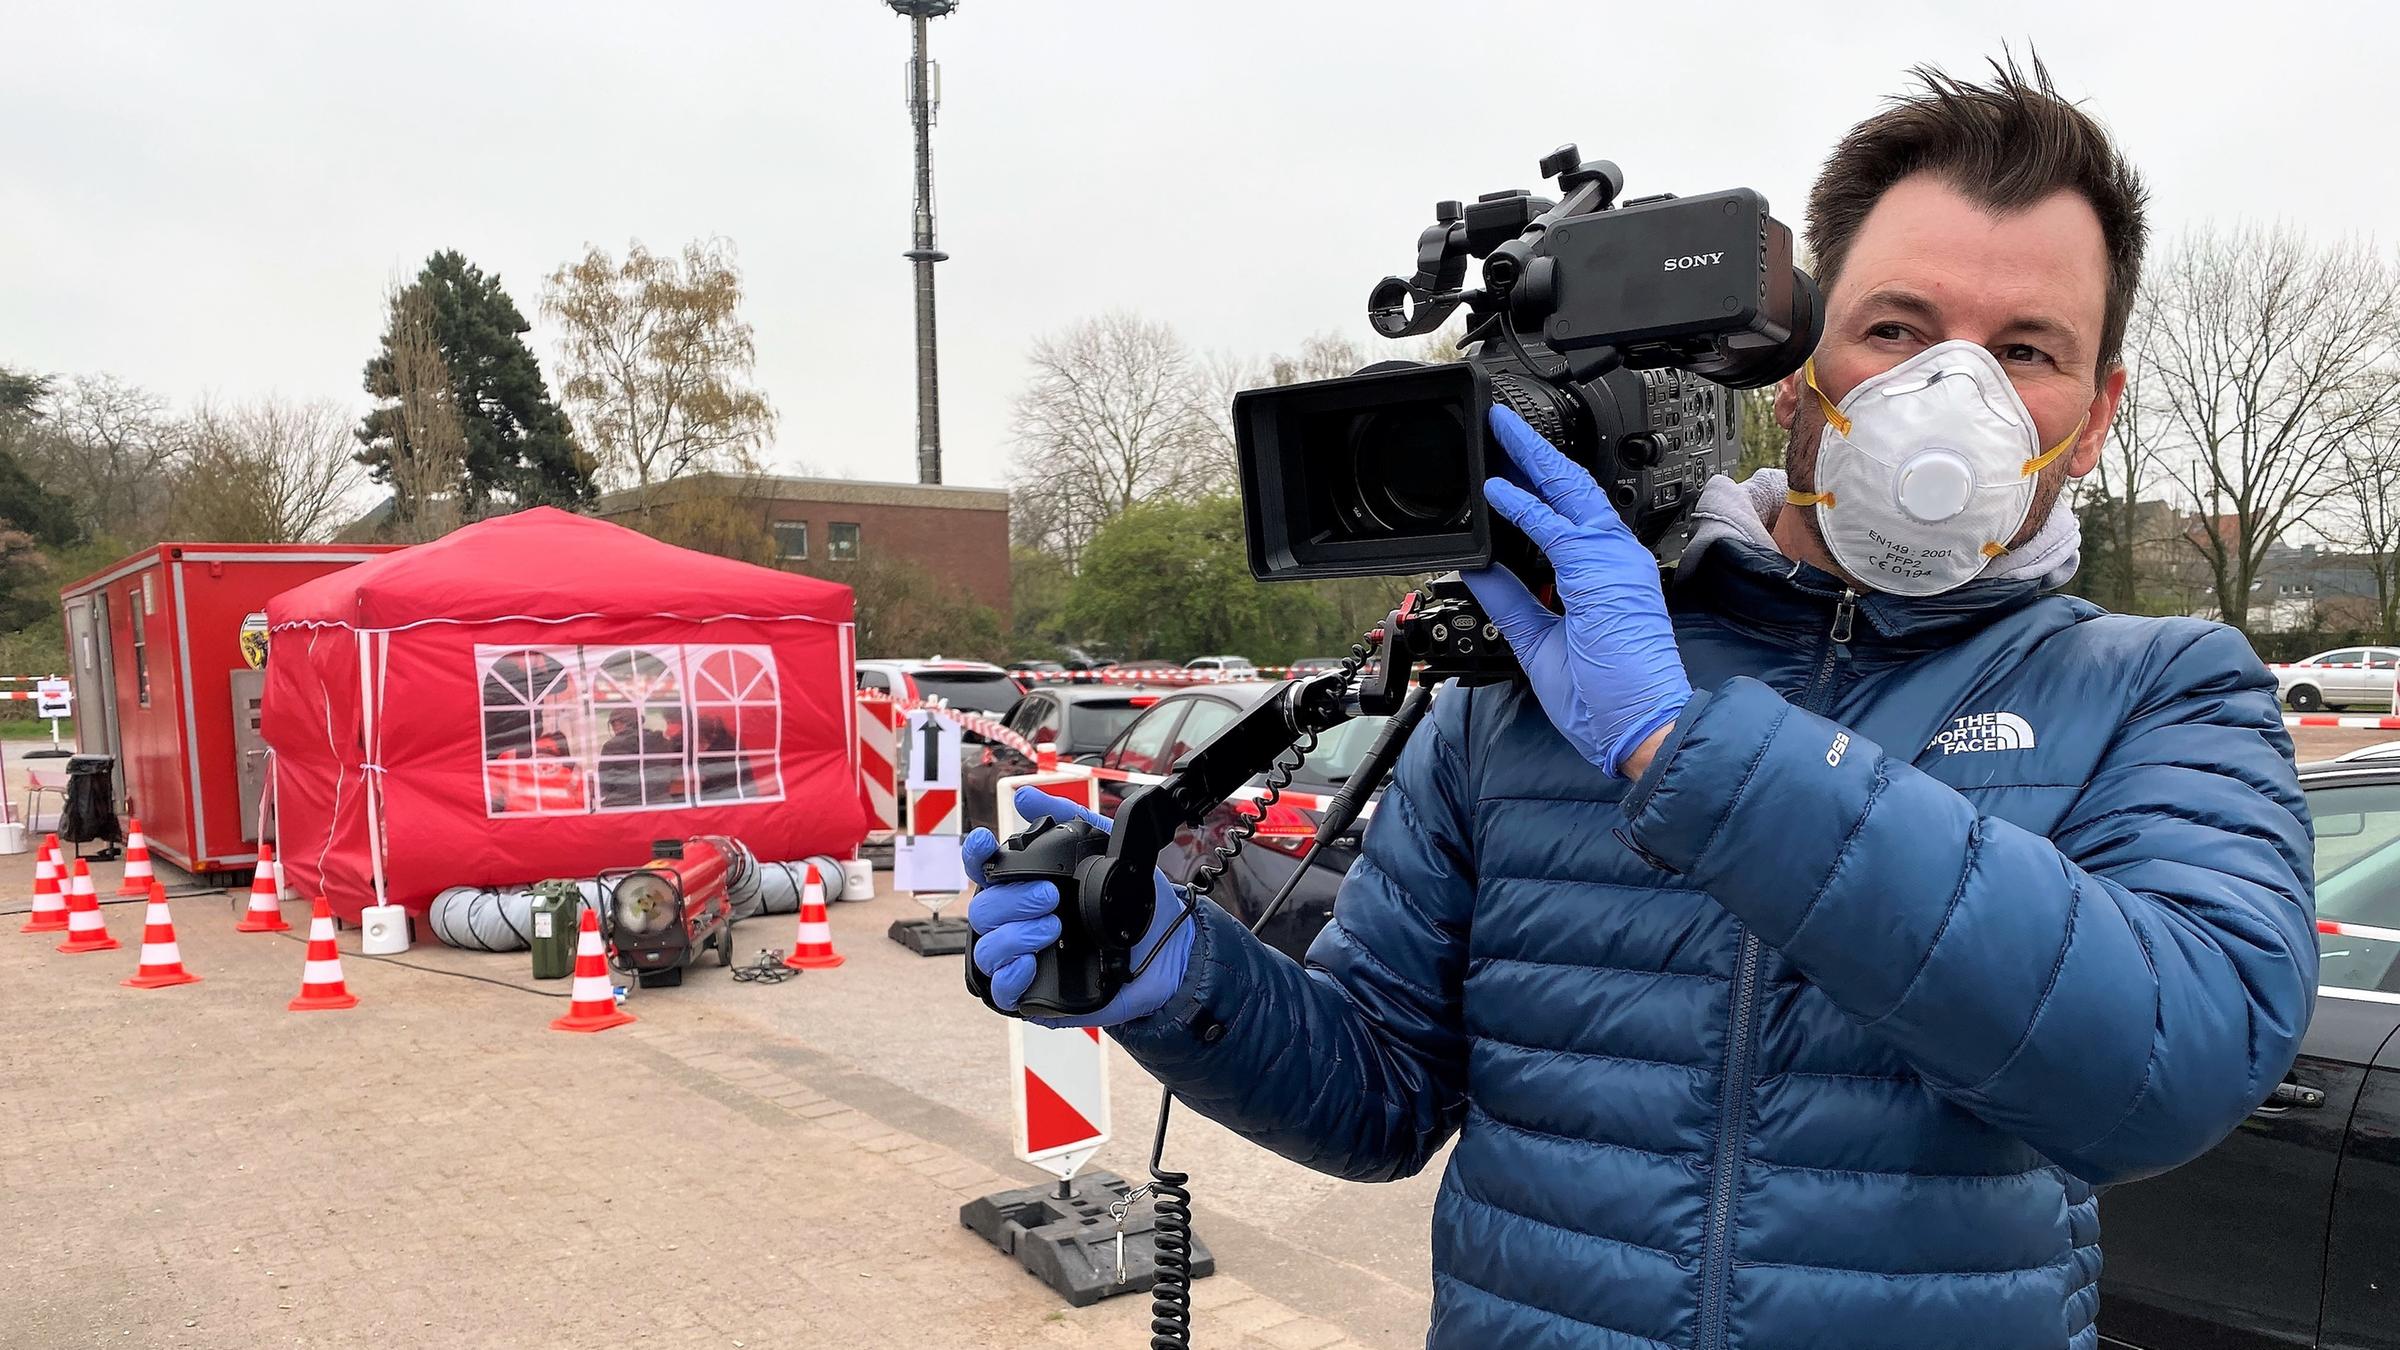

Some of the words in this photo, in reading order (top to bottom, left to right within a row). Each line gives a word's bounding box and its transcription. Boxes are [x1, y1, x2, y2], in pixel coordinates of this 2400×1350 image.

[1664, 251, 1725, 271] SONY
[1868, 529, 1909, 554] EN149
[1921, 549, 1952, 558] 2001
[1885, 552, 1922, 568] FFP2
[1954, 712, 1996, 729] THE
[1826, 732, 1850, 767] 550
[1943, 737, 1997, 755] FACE
